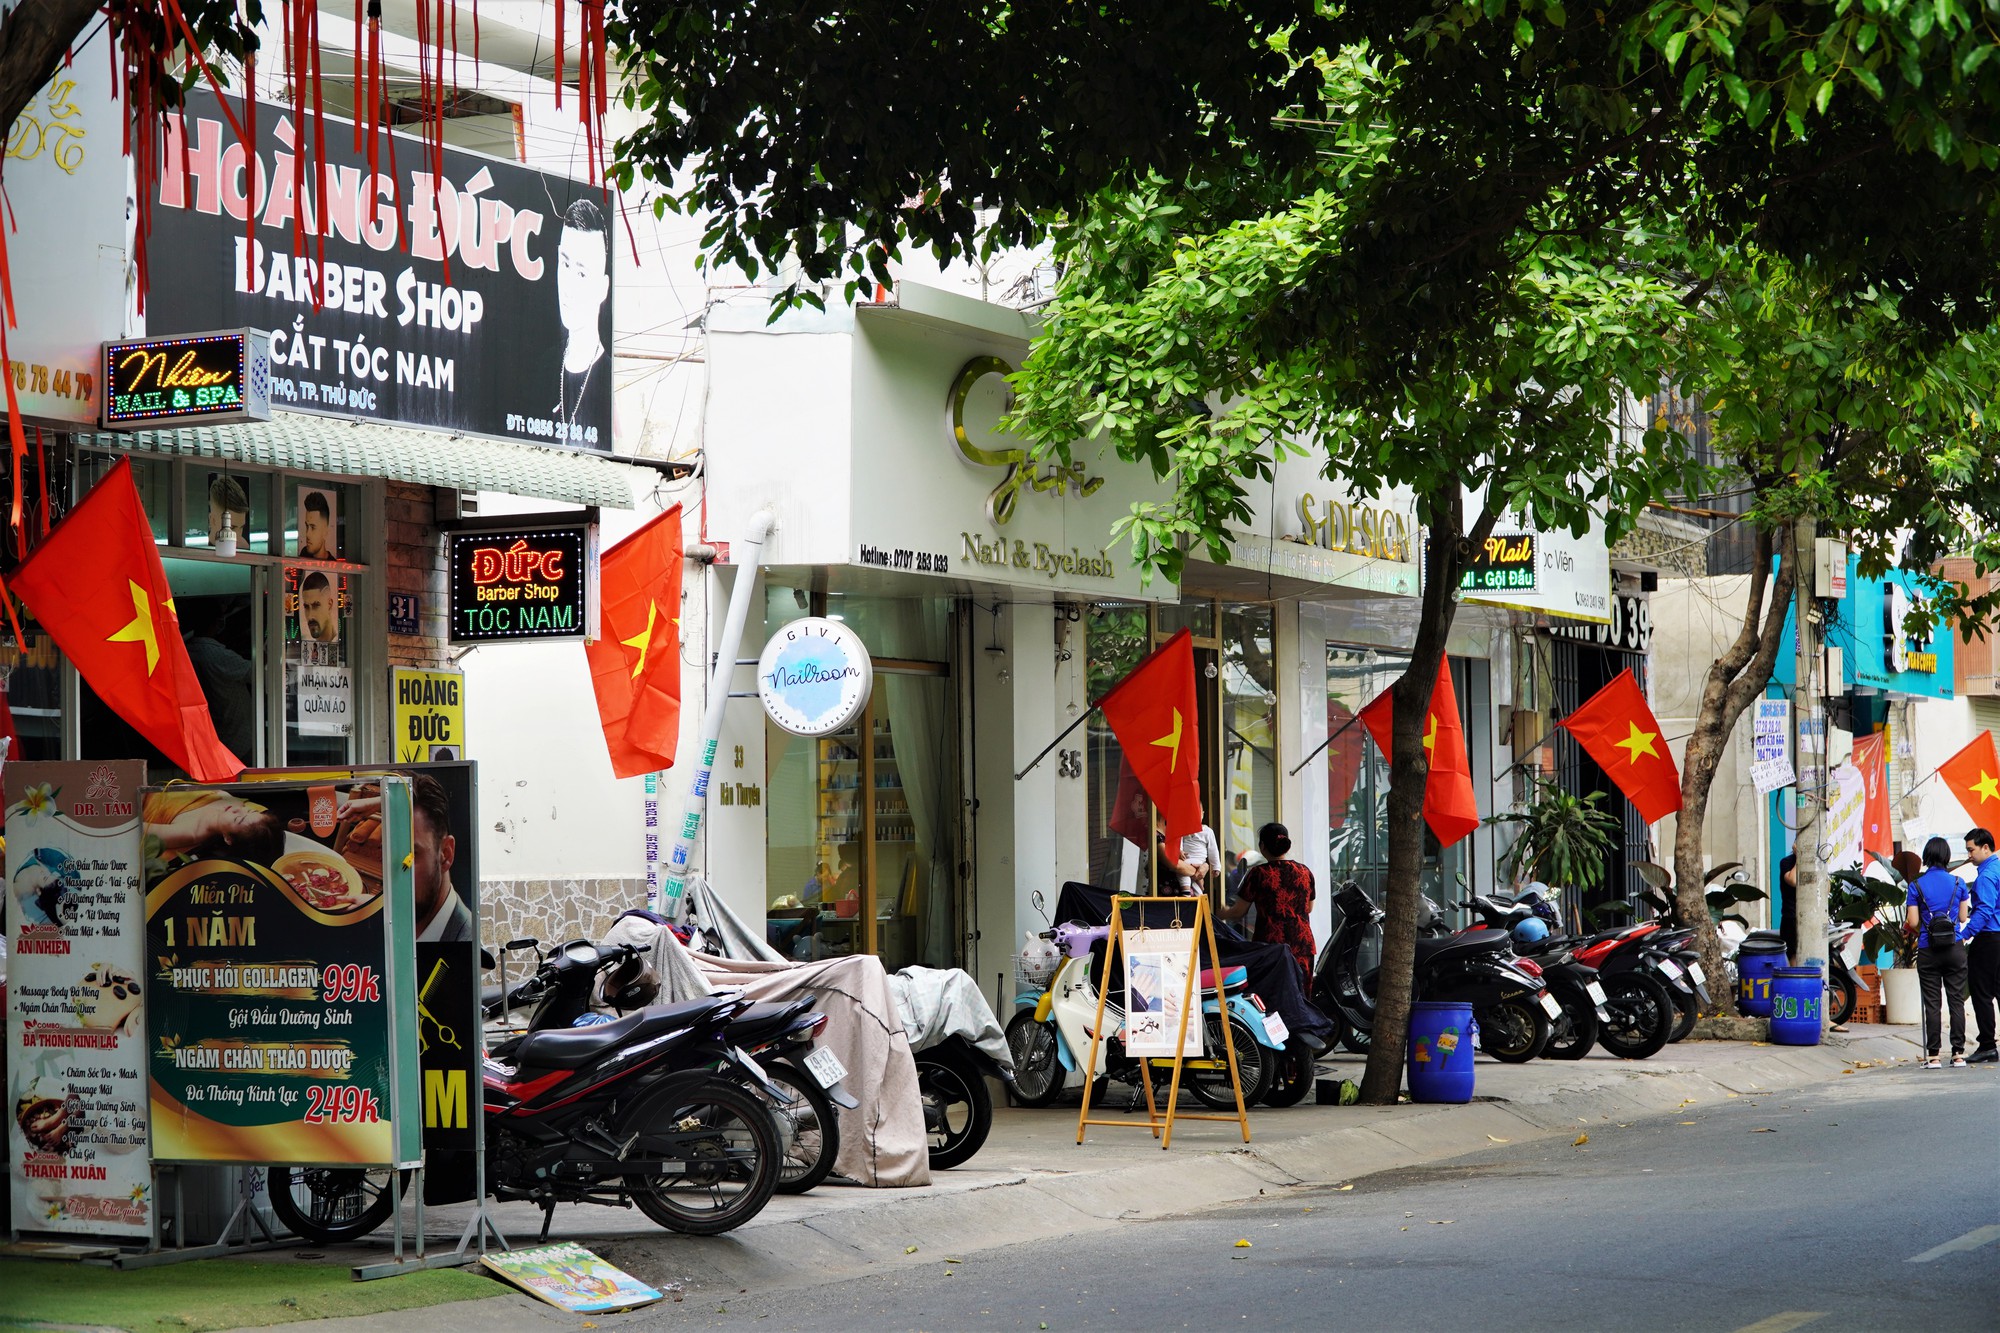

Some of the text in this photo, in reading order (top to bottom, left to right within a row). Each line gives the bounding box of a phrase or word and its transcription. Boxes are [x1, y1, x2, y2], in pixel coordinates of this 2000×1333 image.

[270, 315, 454, 392] CẮT TÓC NAM
[31, 365, 48, 393] 78
[53, 369, 71, 398] 44
[76, 372, 93, 401] 79
[115, 385, 240, 412] NAIL & SPA
[300, 381, 318, 401] TP.
[321, 381, 347, 406] THỦ
[349, 386, 377, 411] ĐỨC
[506, 413, 525, 432] ĐT:
[860, 543, 948, 573] Hotline: 0707 253 033
[960, 531, 1116, 579] Nail & Eyelash
[1484, 536, 1532, 562] Nail
[1555, 549, 1574, 573] Viên
[1485, 569, 1505, 590] Gội
[476, 583, 559, 602] Barber Shop
[392, 596, 416, 619] 31
[464, 602, 572, 631] TÓC NAM
[787, 626, 841, 645] GIVI
[1627, 597, 1650, 650] 39
[302, 672, 327, 690] NHẬN
[762, 662, 860, 689] Nailroom
[399, 674, 458, 706] HOÀNG
[304, 695, 346, 713] QUẦN ÁO
[409, 708, 450, 741] ĐỨC
[734, 745, 743, 768] 33
[1059, 748, 1082, 779] 35
[74, 800, 132, 816] DR. TÂM
[65, 876, 94, 890] Massage
[109, 875, 121, 887] Vai
[190, 880, 254, 905] Miễn Phí
[102, 926, 120, 937] Mask
[164, 910, 256, 947] 1 NĂM
[17, 937, 71, 954] AN NHIÊN
[173, 960, 318, 992] PHỤC HỒI COLLAGEN
[323, 964, 380, 1002] 99k
[20, 985, 49, 999] Massage
[51, 985, 68, 1000] Body
[81, 985, 100, 1000] Nóng
[228, 1005, 352, 1029] Gội Đầu Dưỡng Sinh
[1773, 996, 1819, 1020] 39 H
[39, 1032, 71, 1048] THÔNG
[74, 1035, 97, 1048] KINH
[100, 1035, 119, 1051] LẠC
[175, 1043, 351, 1073] NGÂM CHÂN THẢO DƯỢC
[101, 1068, 111, 1079] Da
[119, 1068, 138, 1079] Mask
[67, 1083, 97, 1097] Massage
[207, 1084, 244, 1106] Thông
[247, 1086, 276, 1102] Kinh
[279, 1086, 299, 1107] Lạc
[120, 1101, 136, 1112] Sinh
[304, 1085, 379, 1124] 249k
[68, 1117, 98, 1131] Massage
[115, 1117, 127, 1127] Vai
[24, 1164, 107, 1180] THANH XUÂN
